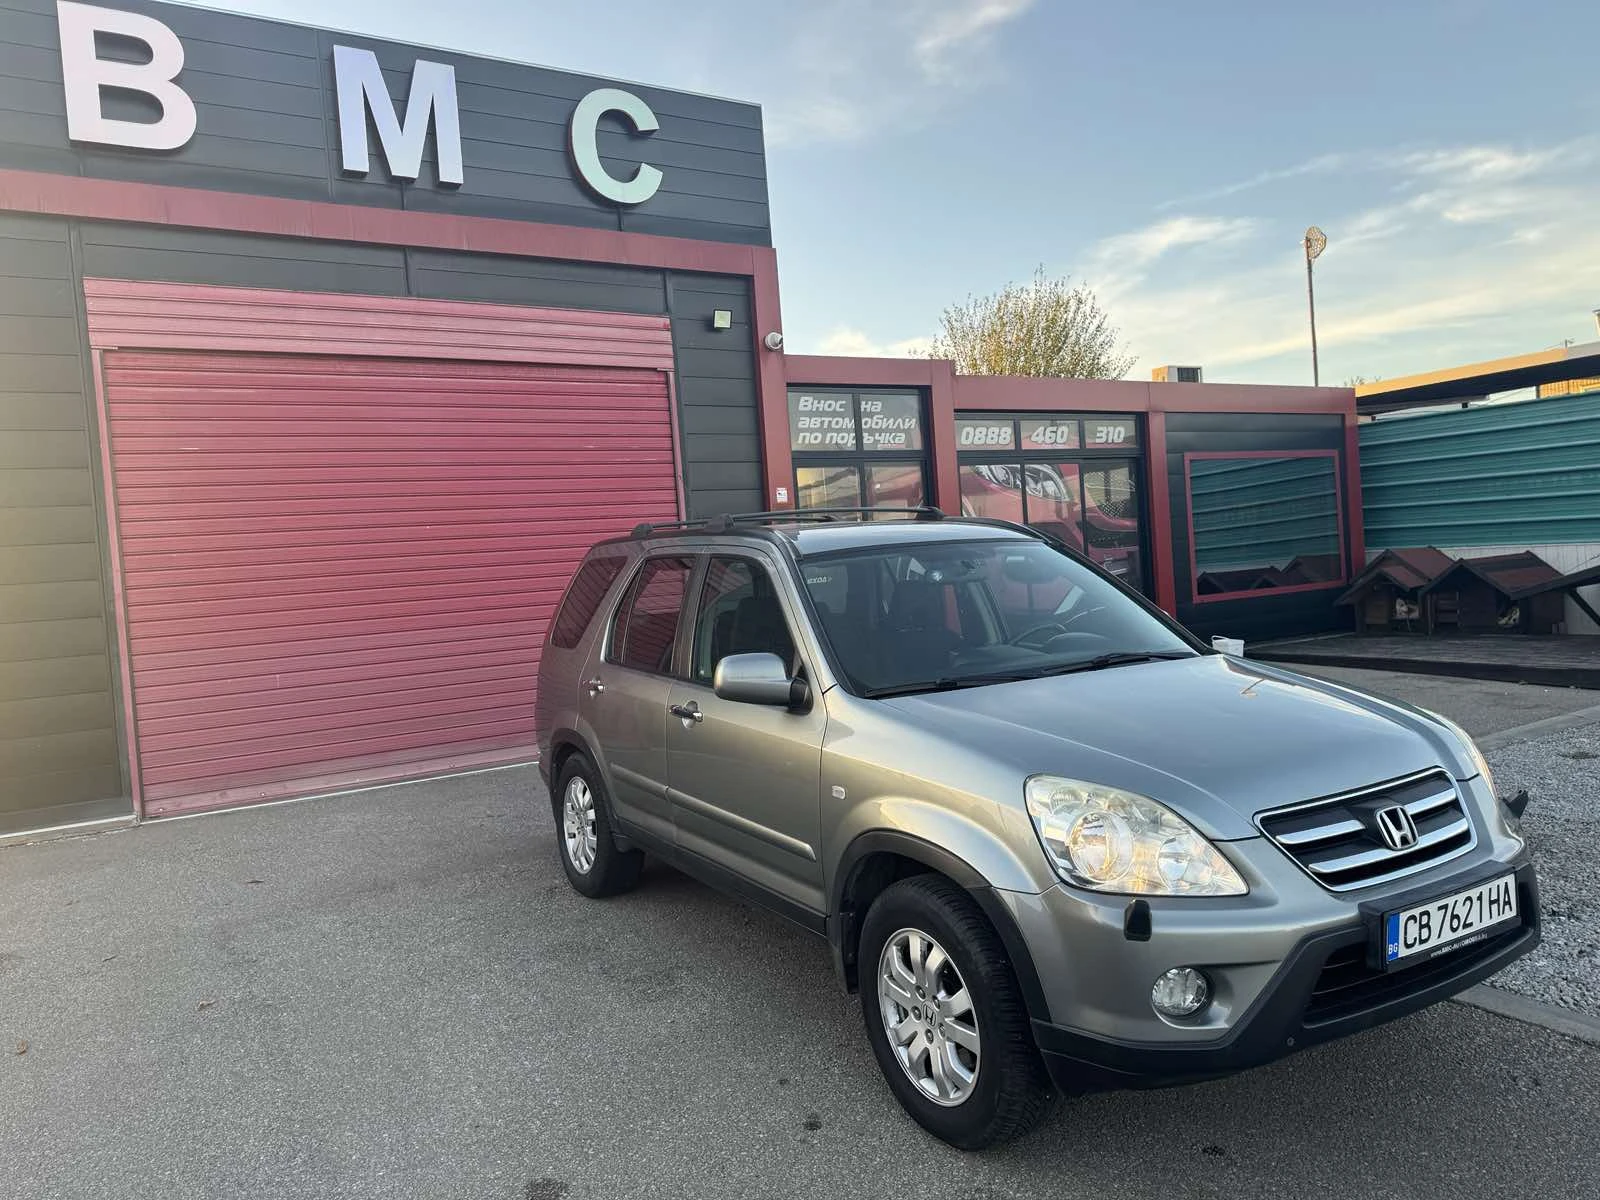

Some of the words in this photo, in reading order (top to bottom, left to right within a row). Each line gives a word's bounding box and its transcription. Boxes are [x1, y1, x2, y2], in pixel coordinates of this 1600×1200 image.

[798, 396, 846, 412] Внос
[860, 399, 882, 412] на
[797, 414, 917, 430] автомобили
[798, 432, 822, 445] по
[960, 426, 1012, 445] 0888
[1030, 425, 1070, 444] 460
[1095, 426, 1126, 444] 310
[1403, 910, 1432, 949] CB
[1437, 890, 1484, 940] 7621
[1488, 881, 1513, 920] HA
[1388, 942, 1399, 955] BG
